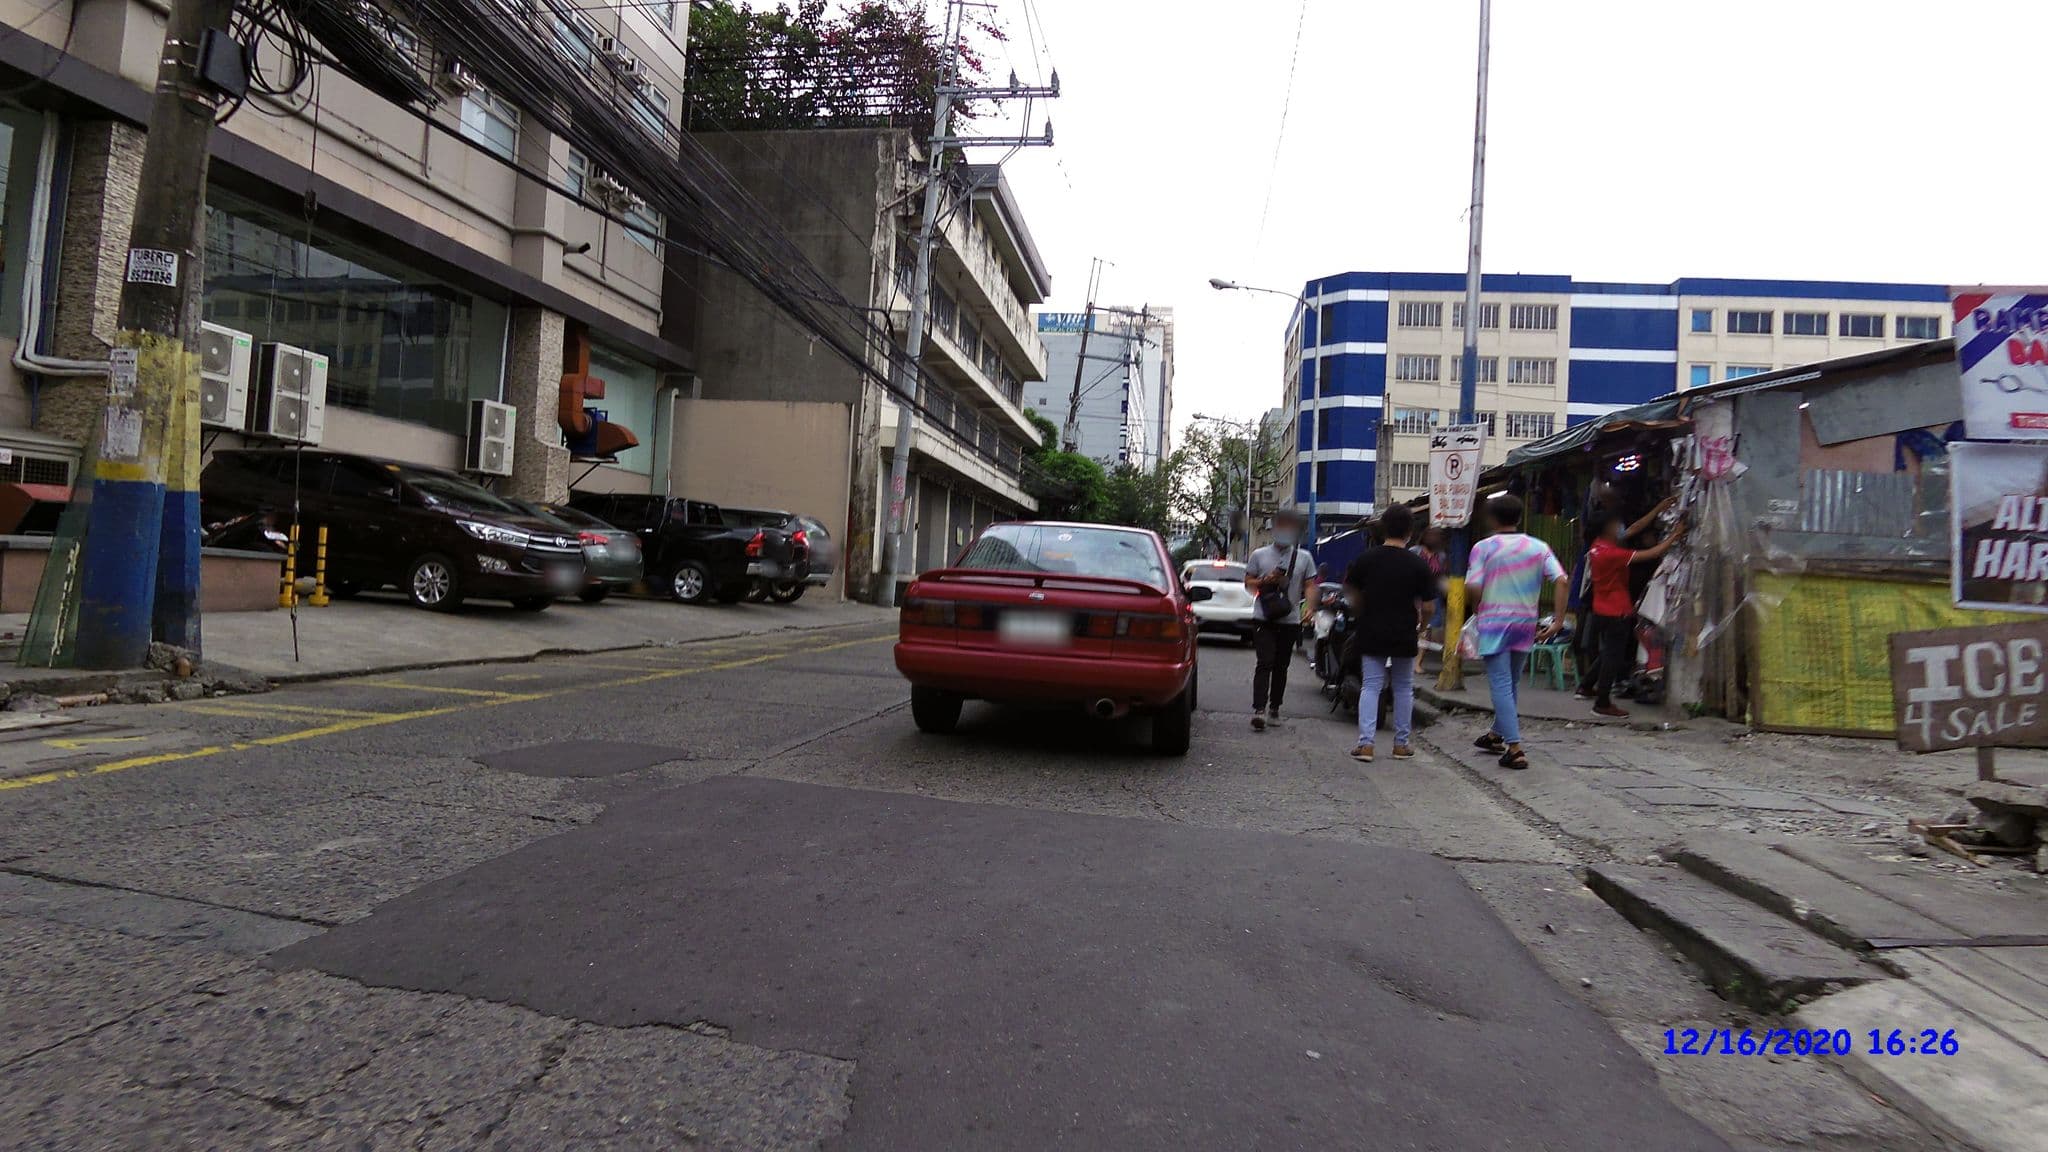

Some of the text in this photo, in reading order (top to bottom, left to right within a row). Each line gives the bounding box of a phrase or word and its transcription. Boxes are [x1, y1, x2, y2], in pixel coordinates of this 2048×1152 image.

[133, 249, 174, 265] TUBERO
[1906, 638, 2045, 702] ICE
[1904, 701, 2040, 750] 4 SALE
